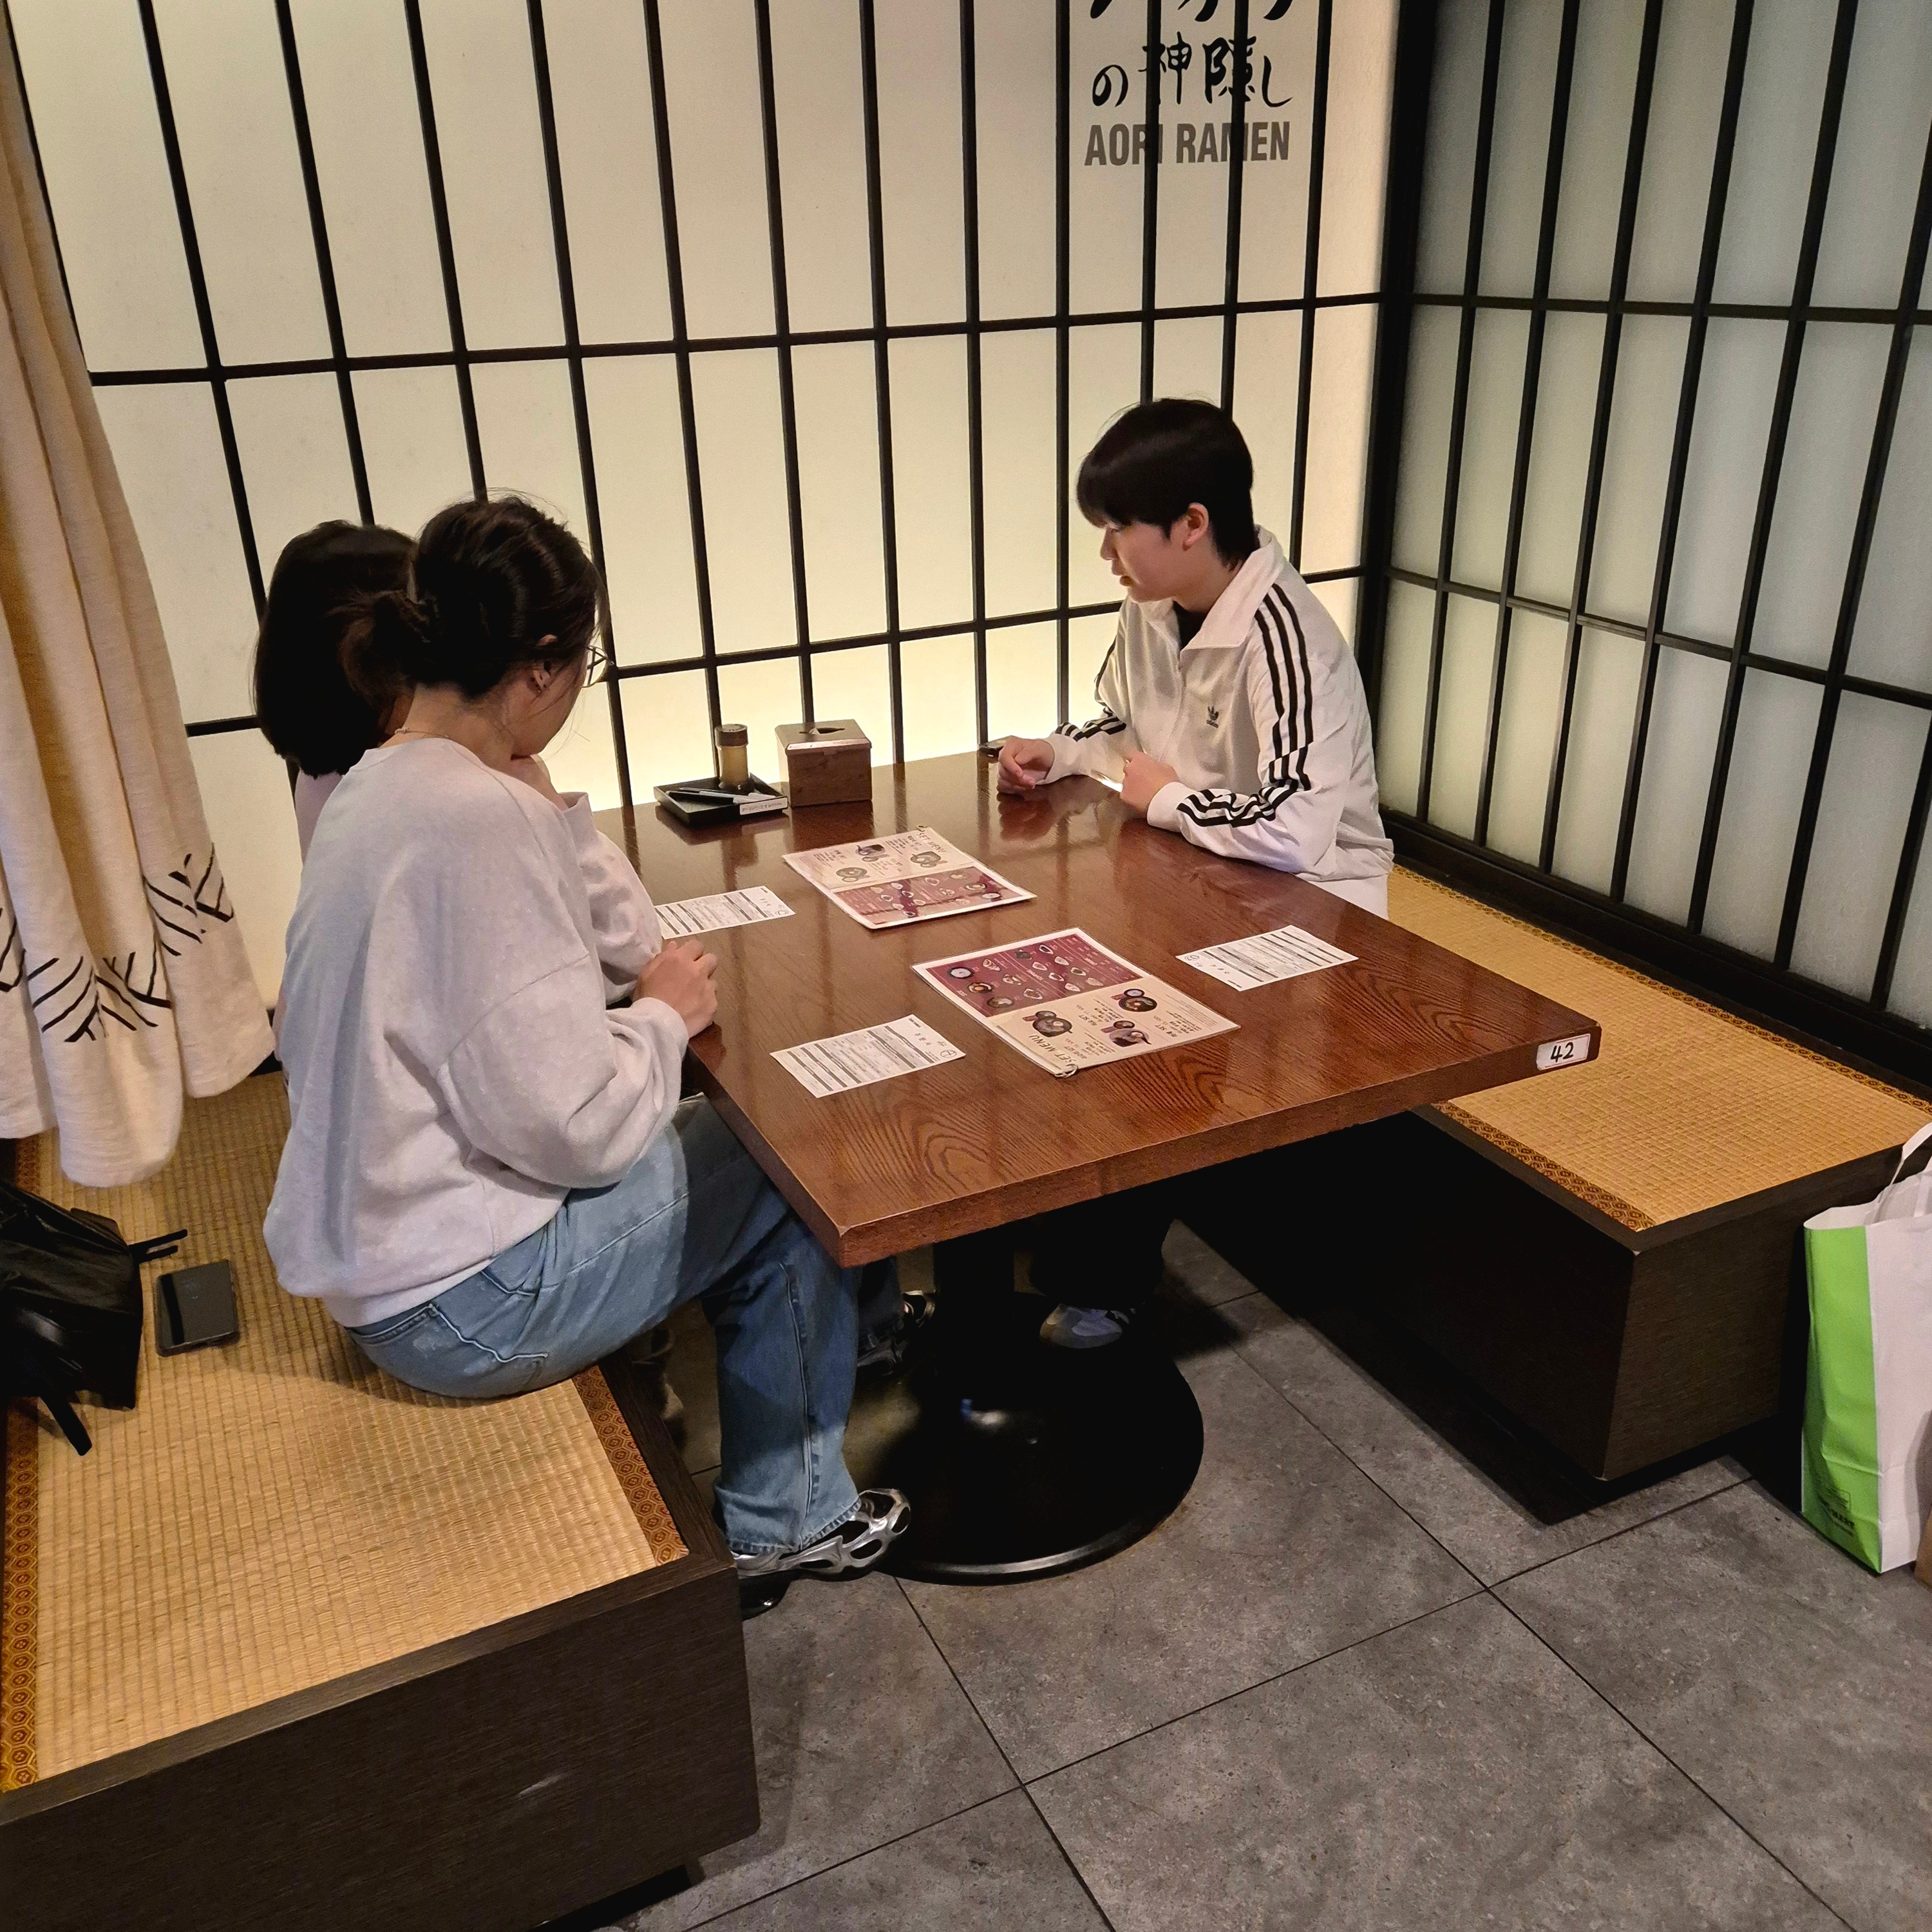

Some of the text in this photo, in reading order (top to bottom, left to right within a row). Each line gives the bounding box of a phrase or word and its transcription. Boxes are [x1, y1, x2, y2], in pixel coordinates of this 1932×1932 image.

[916, 832, 931, 840] SET
[1028, 1035, 1057, 1052] MENU
[1054, 1052, 1075, 1063] SET
[1550, 1041, 1574, 1063] 42
